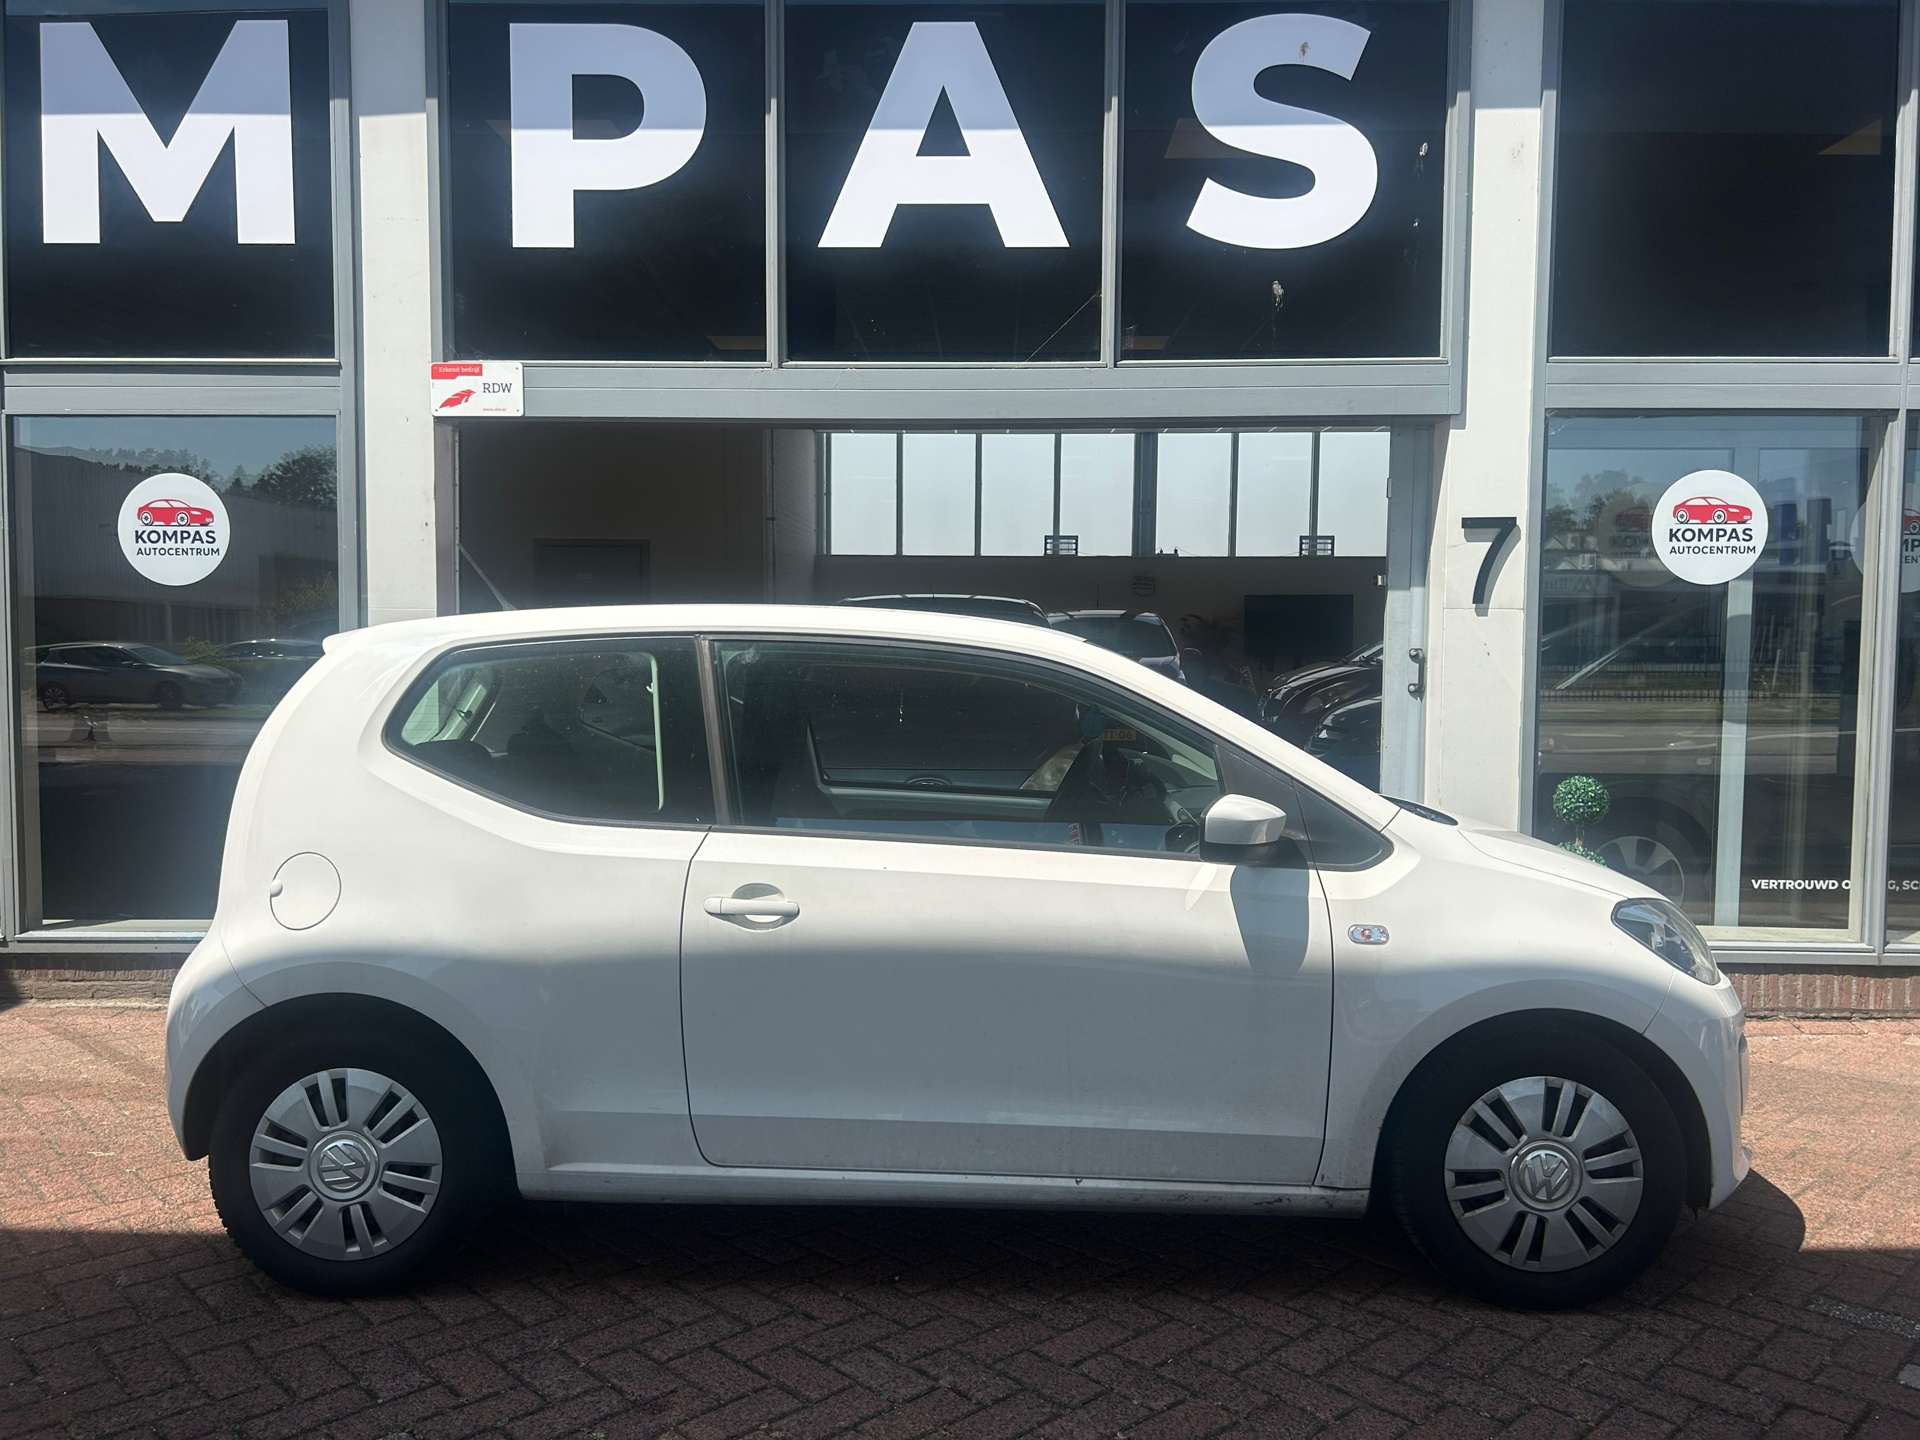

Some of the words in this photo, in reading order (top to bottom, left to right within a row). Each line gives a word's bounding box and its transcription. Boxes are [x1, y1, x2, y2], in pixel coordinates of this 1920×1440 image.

[483, 383, 512, 393] RDW
[134, 529, 217, 545] KOMPAS
[1668, 527, 1754, 543] KOMPAS
[136, 547, 220, 556] AUTOCENTRUM
[1669, 545, 1756, 555] AUTOCENTRUM
[1461, 516, 1518, 605] 7
[1751, 878, 1838, 890] VERTROUWD
[1902, 879, 1920, 890] SC
